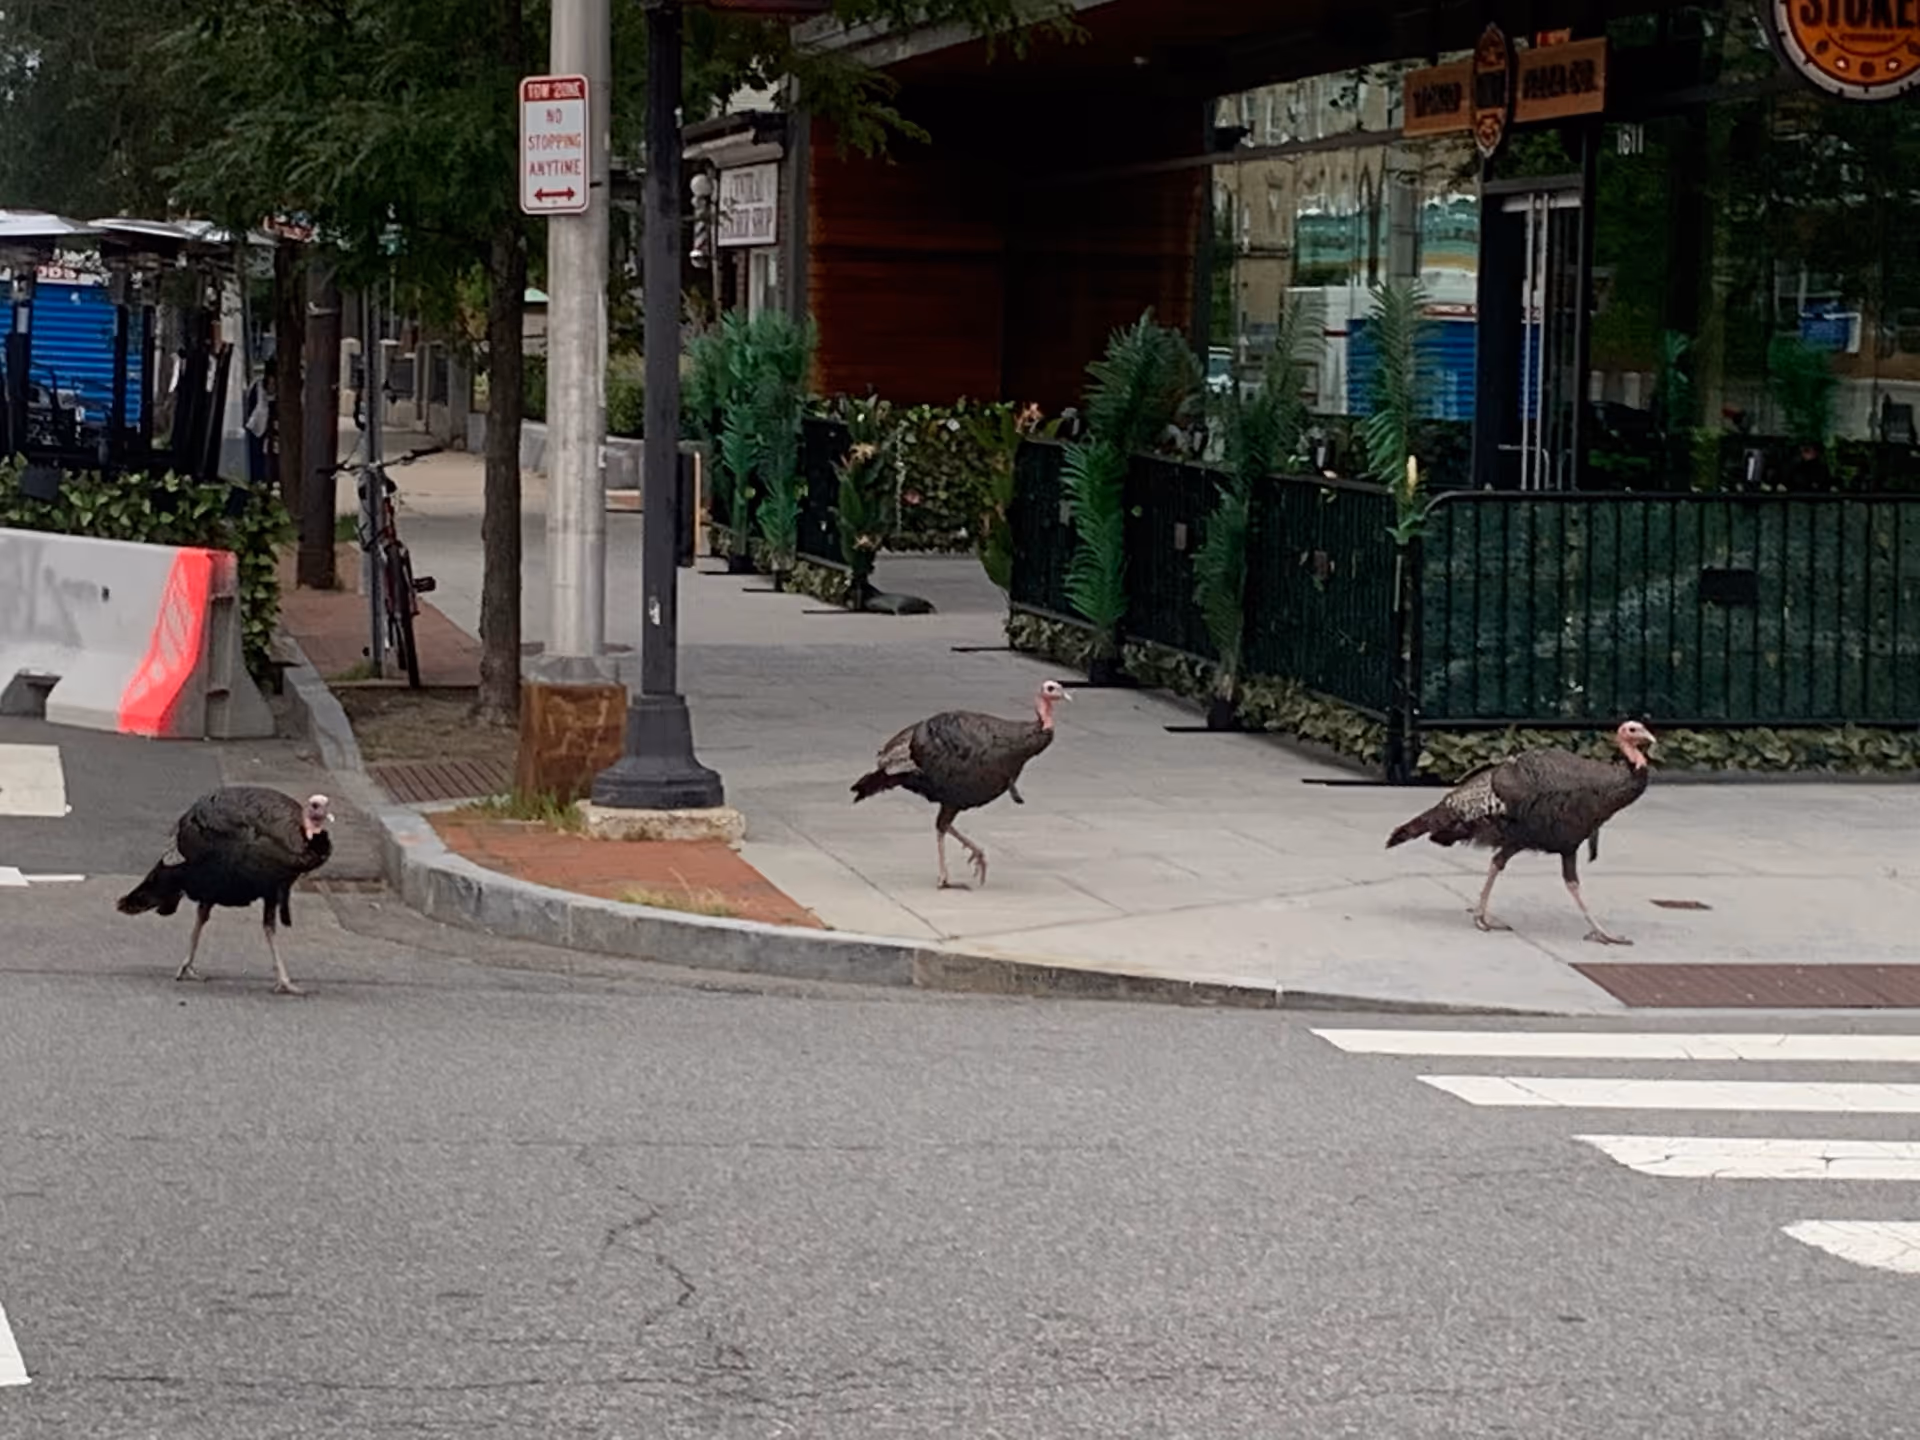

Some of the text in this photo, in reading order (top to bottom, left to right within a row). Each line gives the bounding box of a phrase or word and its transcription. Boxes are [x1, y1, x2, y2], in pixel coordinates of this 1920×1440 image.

[1800, 0, 1920, 29] STOKE
[527, 83, 550, 99] TOW
[545, 108, 563, 124] NO
[528, 133, 582, 151] STOPPING
[529, 159, 582, 177] ANYTIME
